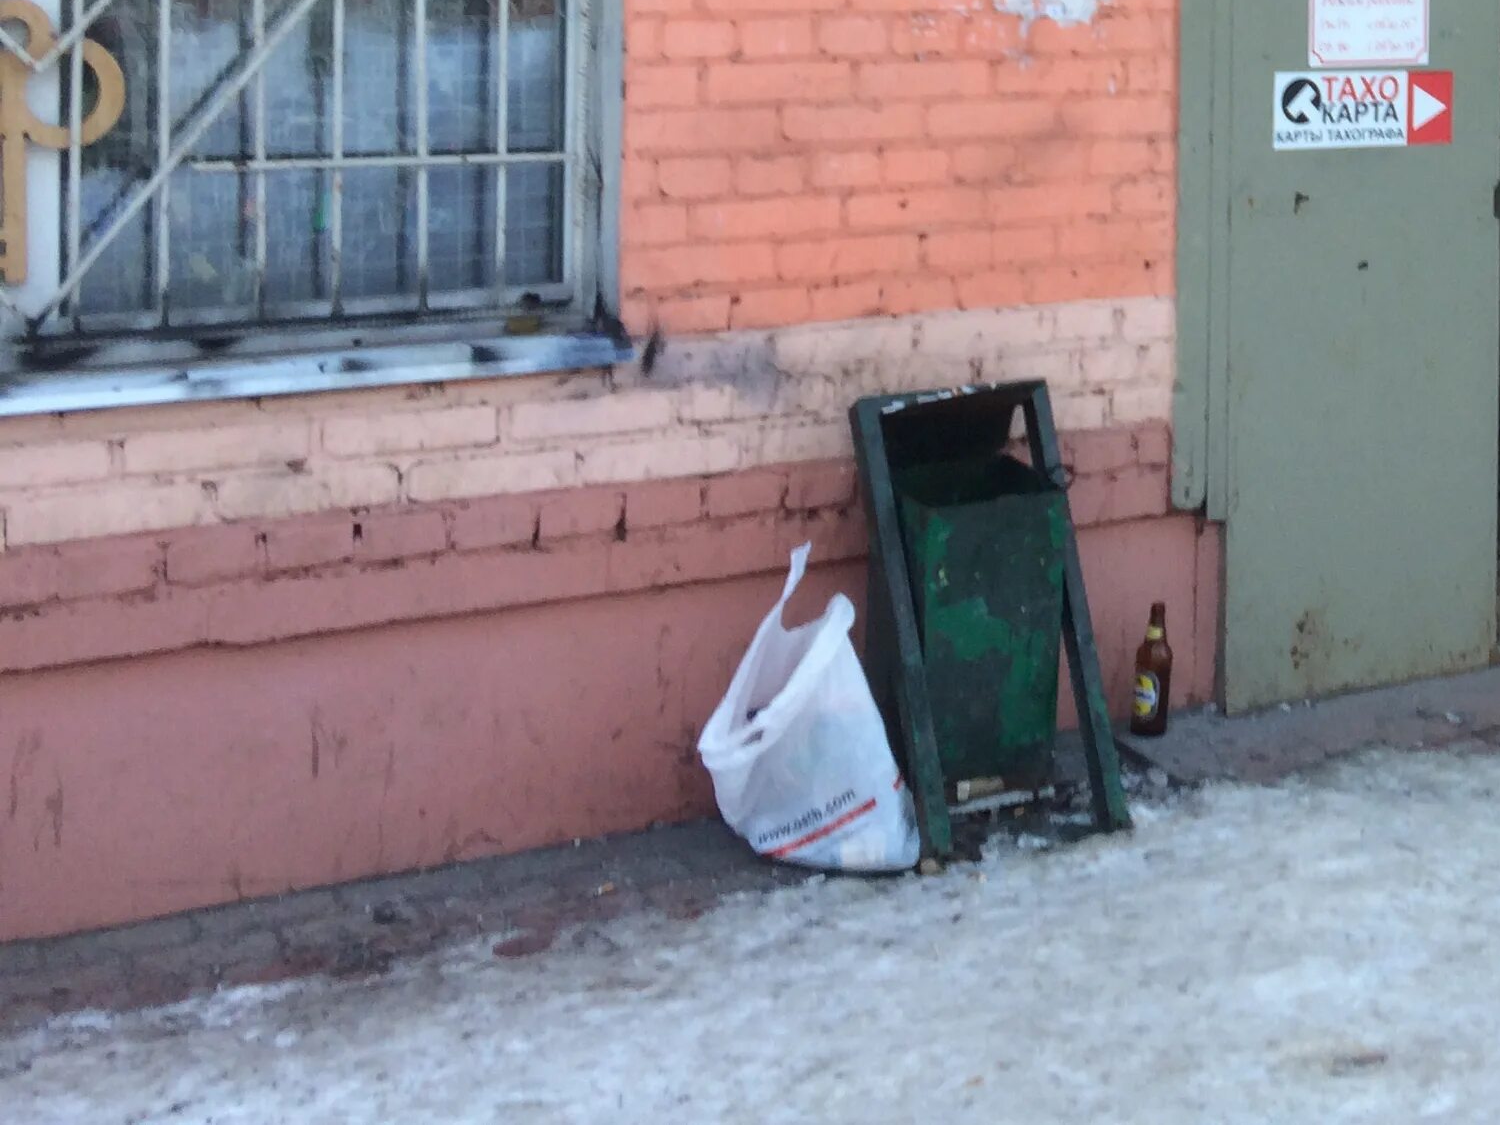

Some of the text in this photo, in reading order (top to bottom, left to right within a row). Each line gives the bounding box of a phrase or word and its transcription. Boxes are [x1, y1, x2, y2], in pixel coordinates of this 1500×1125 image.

[1321, 75, 1399, 102] ТАХО
[1319, 102, 1399, 124] КАРТА
[1277, 127, 1404, 143] КАРТЫ ТАХОГРАФА
